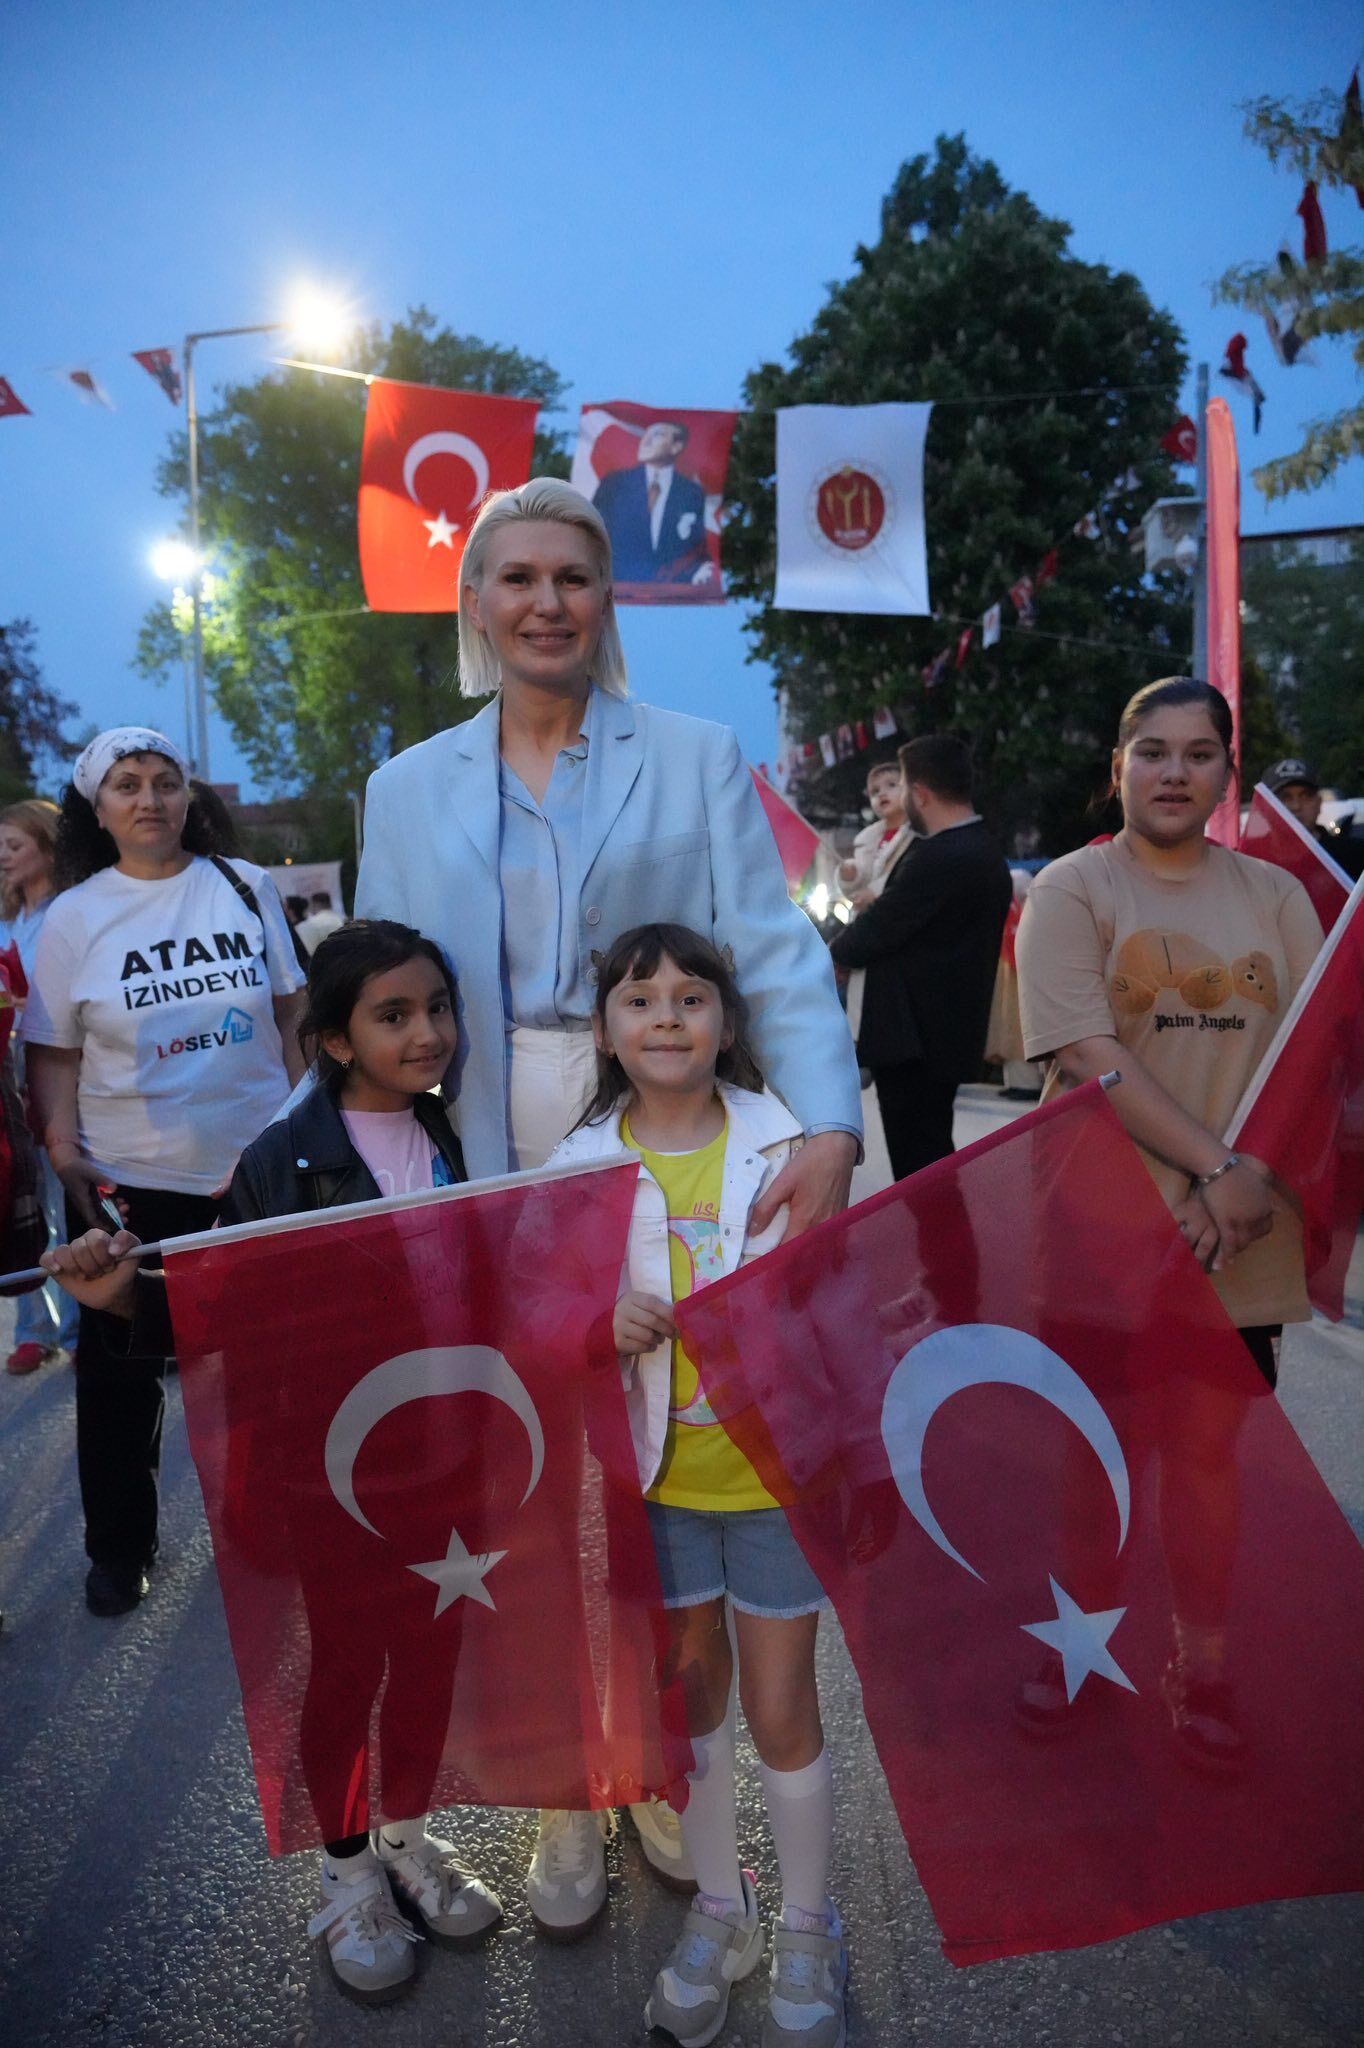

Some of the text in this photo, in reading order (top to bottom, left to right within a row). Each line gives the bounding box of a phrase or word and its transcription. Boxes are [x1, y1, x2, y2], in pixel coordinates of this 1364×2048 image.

[120, 931, 254, 981] ATAM
[123, 965, 263, 1010] İZİNDEYİZ
[1155, 1013, 1246, 1032] Palm Angels
[157, 1030, 228, 1059] LÖSEV
[693, 1200, 719, 1218] U.S.
